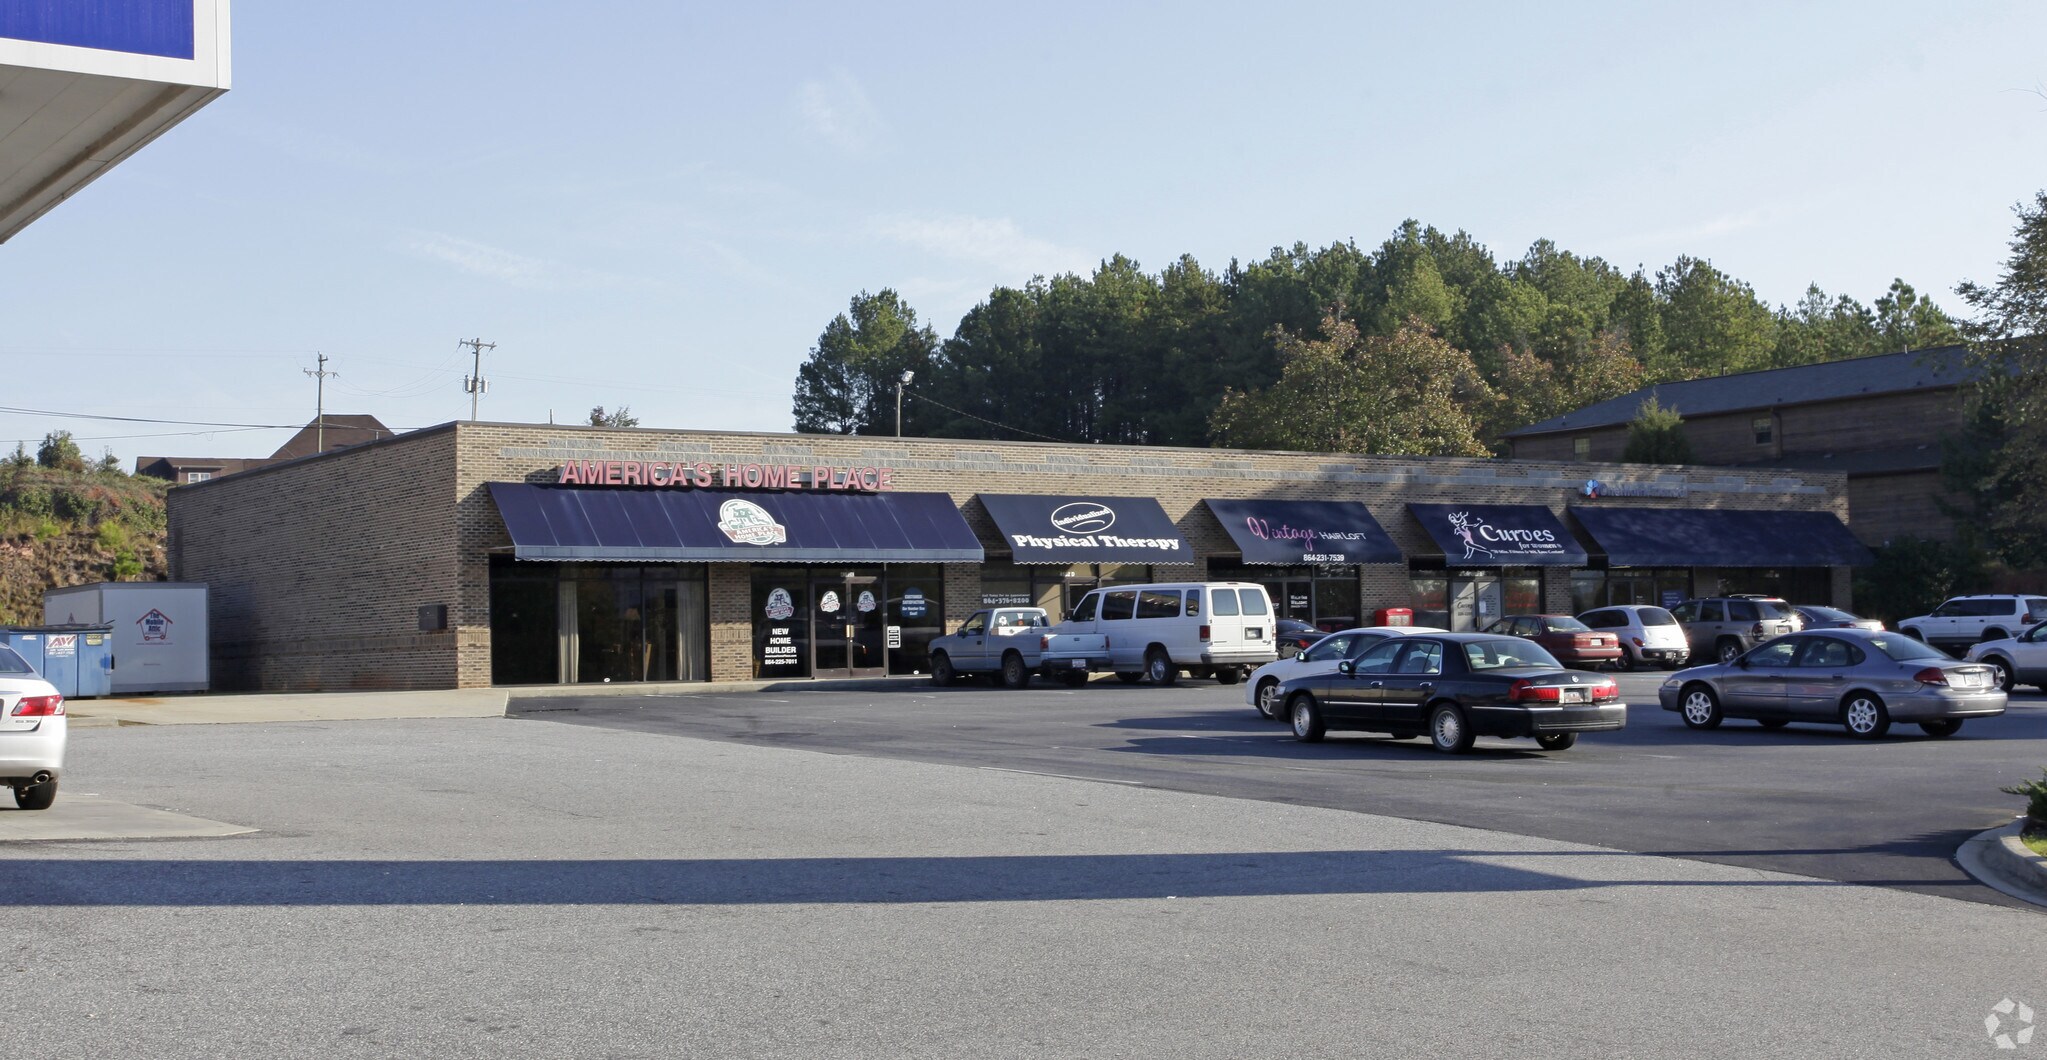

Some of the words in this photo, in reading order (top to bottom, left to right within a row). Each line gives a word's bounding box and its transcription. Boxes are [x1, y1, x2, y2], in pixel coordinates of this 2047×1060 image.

[559, 460, 713, 487] AMERICA'S
[724, 463, 802, 488] HOME
[812, 465, 894, 490] PLACE
[1054, 508, 1111, 526] Individualized
[736, 526, 774, 535] AMERICA'S
[1246, 516, 1318, 552] Vintage
[1319, 531, 1341, 540] HAIR
[1341, 532, 1367, 540] LOFT
[1479, 525, 1555, 541] Curves
[1012, 534, 1099, 549] Physical
[1098, 535, 1179, 550] Therapy
[1519, 542, 1530, 550] for
[1303, 554, 1345, 562] 864-231-7539
[769, 637, 792, 645] HOME
[765, 646, 797, 654] BUILDER
